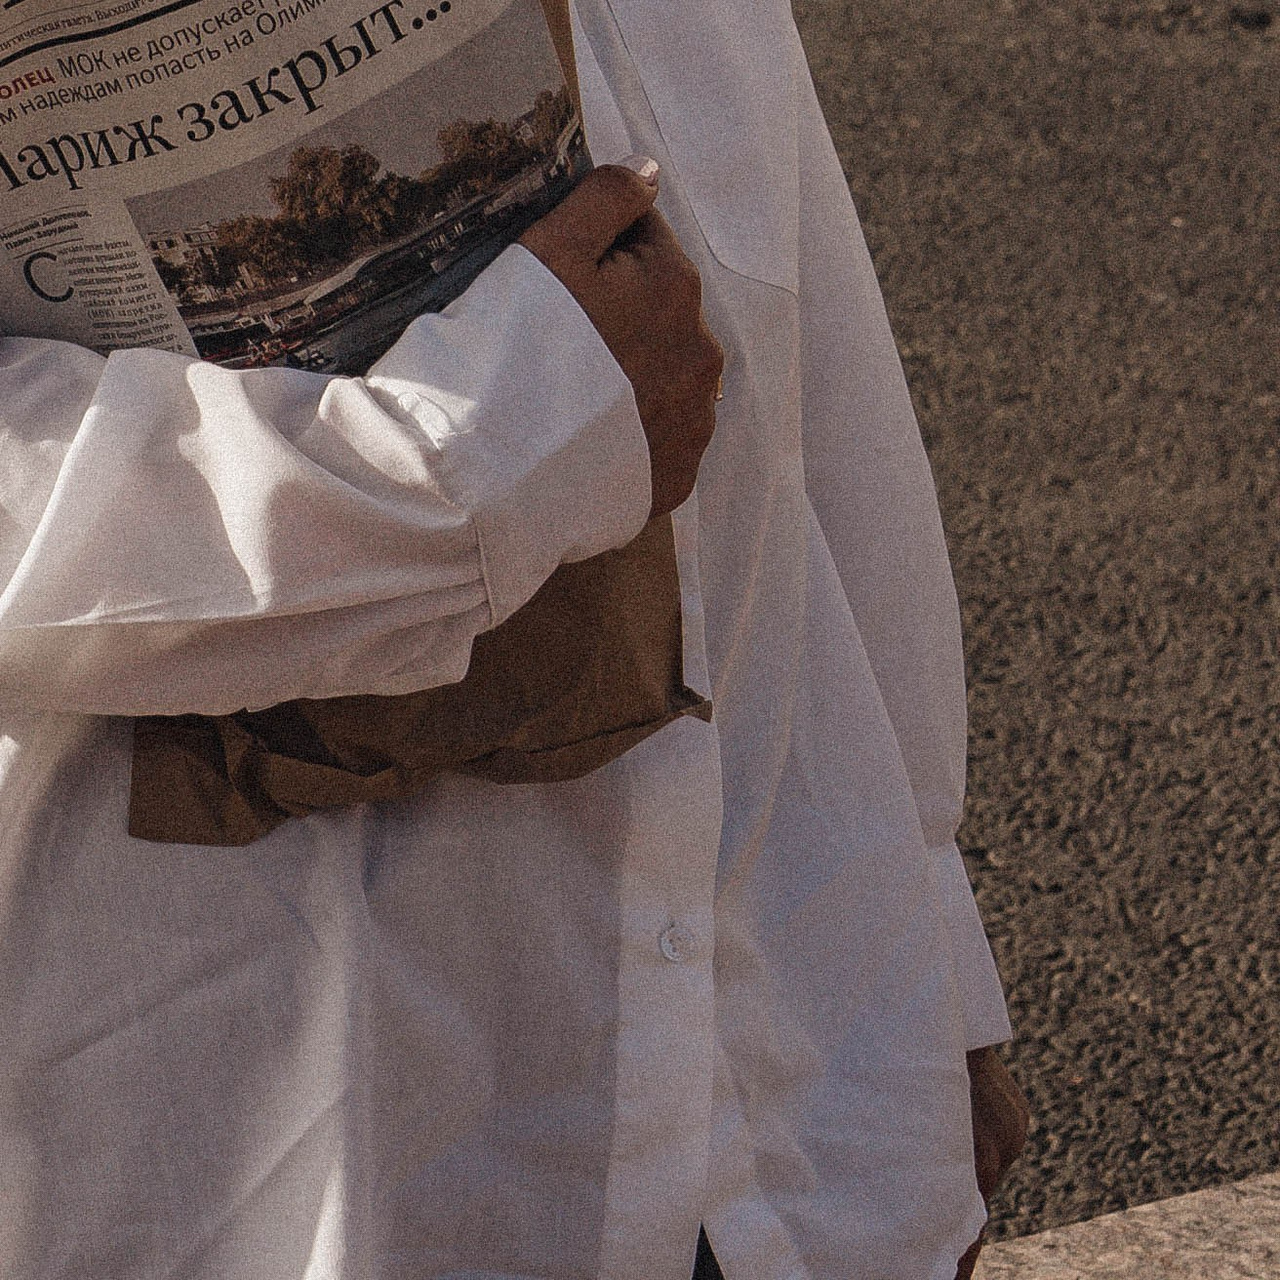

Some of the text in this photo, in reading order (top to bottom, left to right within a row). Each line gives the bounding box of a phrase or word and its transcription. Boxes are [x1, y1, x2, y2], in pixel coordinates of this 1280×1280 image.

[19, 77, 123, 115] надеждам
[126, 45, 222, 89] попасть
[224, 29, 254, 54] на
[57, 50, 112, 78] МОК
[113, 46, 142, 67] не
